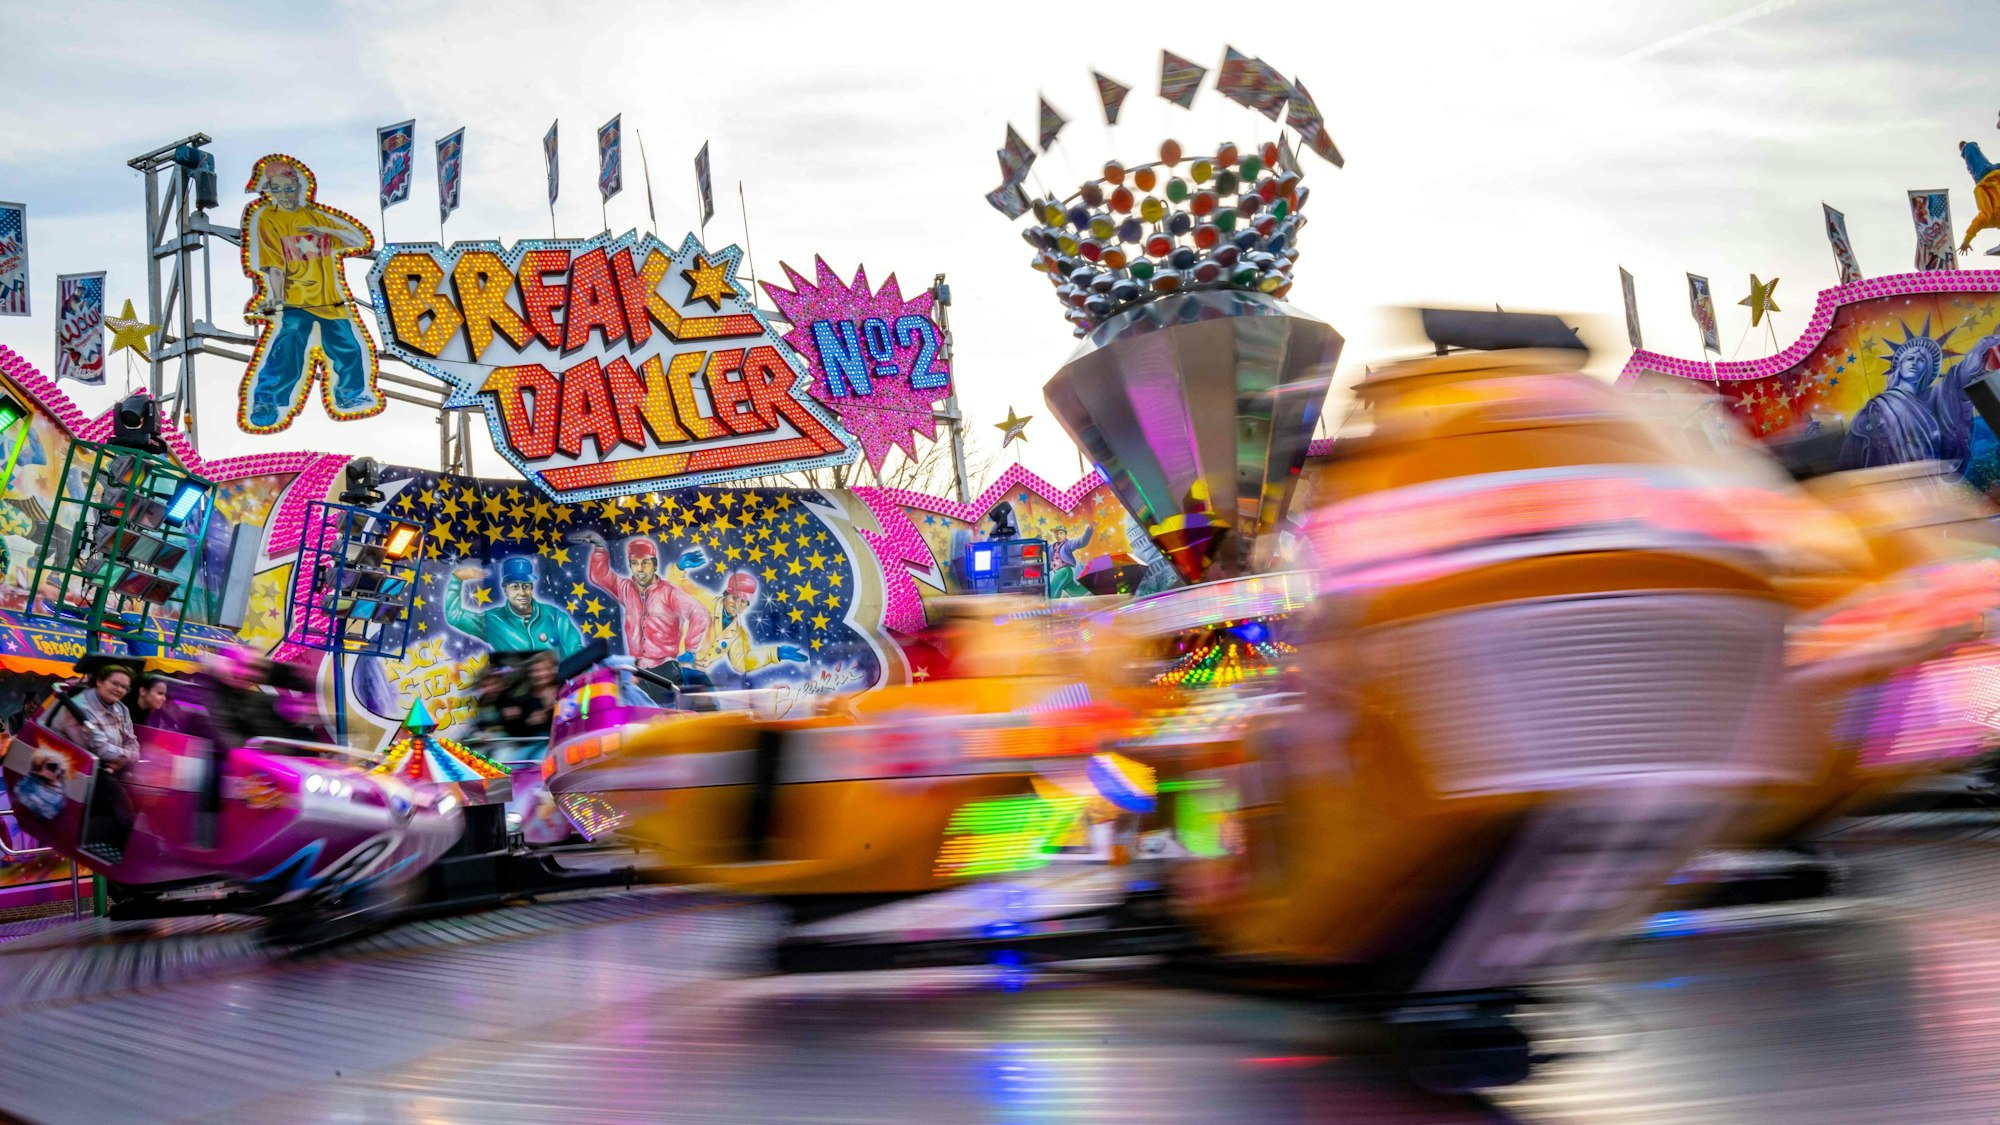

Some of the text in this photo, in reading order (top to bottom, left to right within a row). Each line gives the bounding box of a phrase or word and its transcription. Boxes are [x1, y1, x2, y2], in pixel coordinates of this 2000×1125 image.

[381, 246, 683, 362] BREAK
[479, 345, 812, 461] DANCER
[427, 696, 479, 732] CRE
